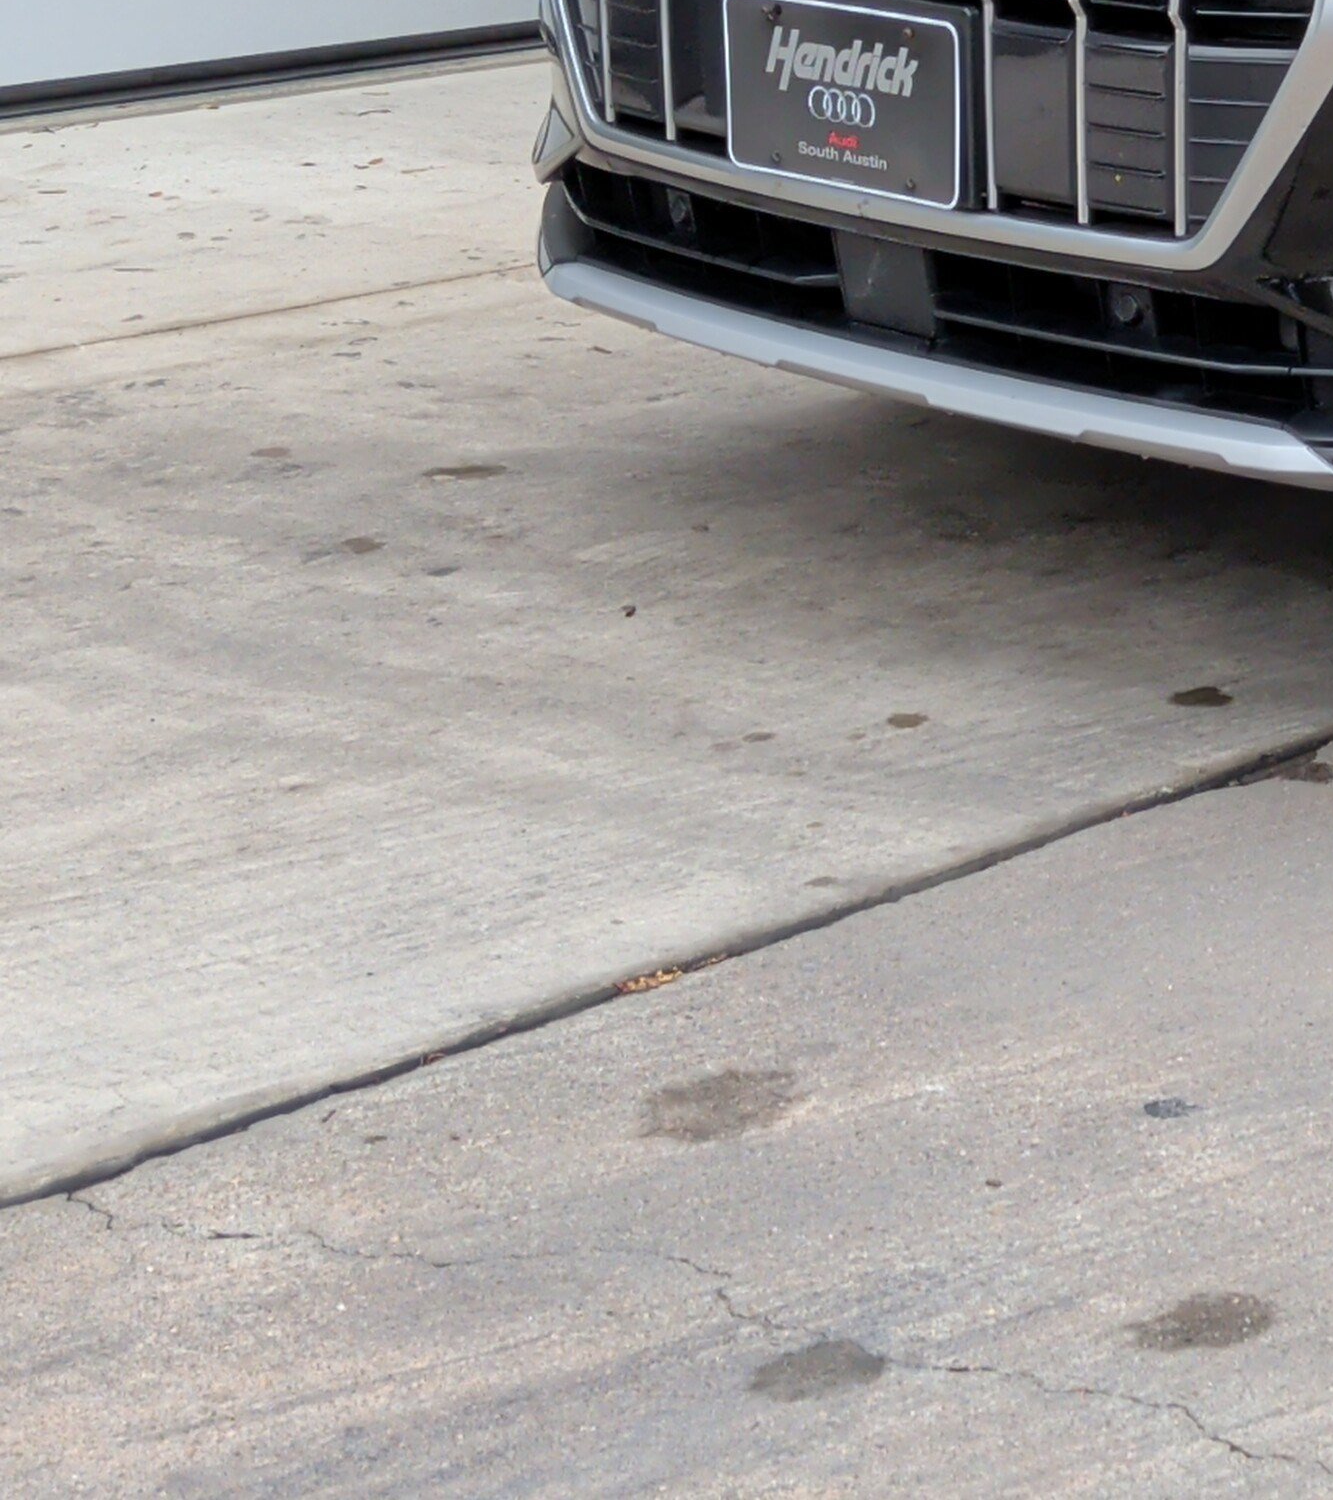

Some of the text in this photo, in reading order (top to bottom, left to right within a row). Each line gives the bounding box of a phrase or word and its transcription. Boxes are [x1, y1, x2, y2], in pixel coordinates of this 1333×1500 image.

[765, 26, 919, 97] Hendrick
[828, 131, 859, 149] Audi
[798, 141, 888, 171] South Austin
